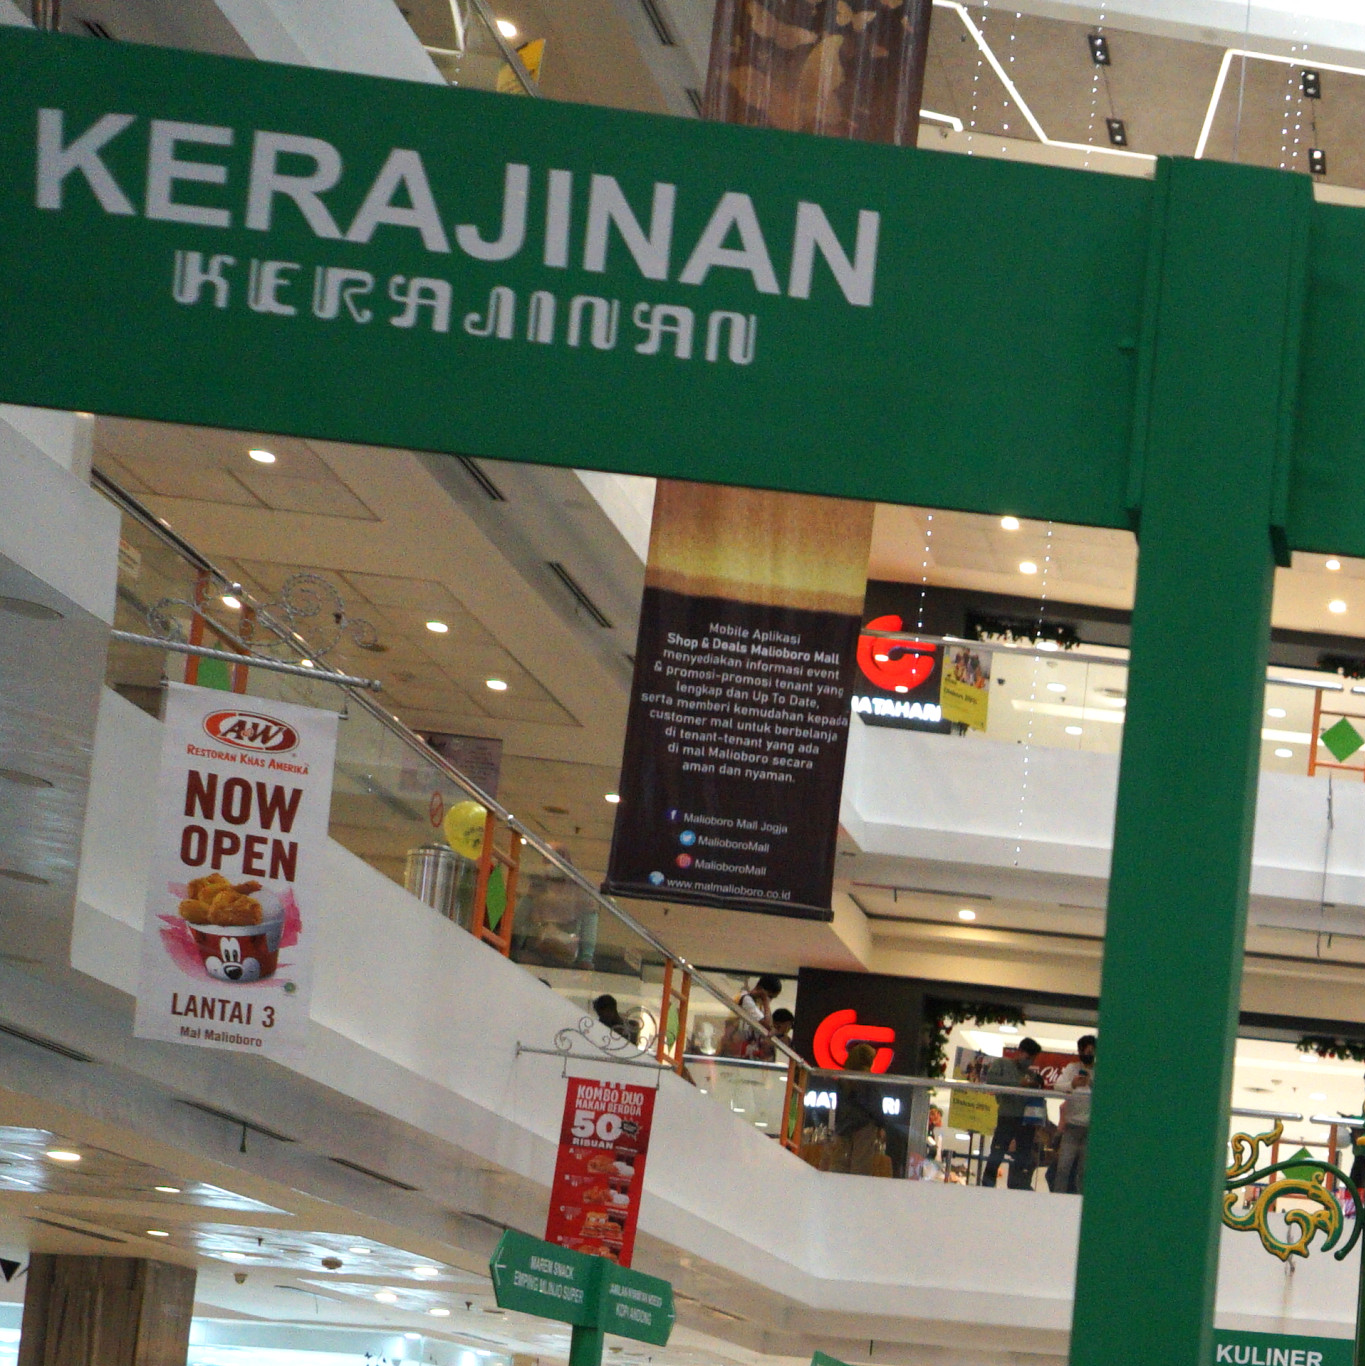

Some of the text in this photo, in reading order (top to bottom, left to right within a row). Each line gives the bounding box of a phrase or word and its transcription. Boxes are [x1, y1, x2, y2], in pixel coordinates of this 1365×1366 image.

[35, 107, 882, 307] KERAJINAN
[171, 249, 758, 366] KERAJINAN
[709, 622, 801, 645] Mobile Aplikasi
[667, 632, 840, 665] Shop & Deals Malioboro Mall
[663, 649, 840, 680] menyediakan informasi event
[654, 661, 844, 698] & promosi-promosi tenant yang
[676, 681, 722, 699] lengkap
[727, 687, 748, 700] dan
[752, 690, 769, 703] Up
[773, 692, 785, 704] To
[641, 692, 848, 727] serta memberi kemudahan kepada
[650, 709, 838, 743] customer mal untuk berbelanja
[665, 726, 820, 756] di tenant-tenant yang ada
[668, 742, 813, 770] di mal Malioboro secara
[682, 760, 795, 784] aman dan nyaman.
[184, 769, 304, 833] NOW
[684, 812, 733, 828] Malioboro
[737, 819, 758, 831] Mall
[761, 822, 788, 836] Jogja
[180, 824, 298, 882] OPEN
[698, 836, 770, 853] MalioboroMall
[695, 859, 767, 876] MalioboroMall
[667, 878, 791, 900] www.malmalioboro.co.id
[171, 992, 275, 1029] LANTAI 3
[180, 1026, 263, 1047] Mal Malioboro
[575, 1098, 606, 1111] MAKAN
[577, 1085, 644, 1106] KOMBO DUO
[571, 1109, 622, 1141] 50
[572, 1137, 613, 1150] RIBUAN
